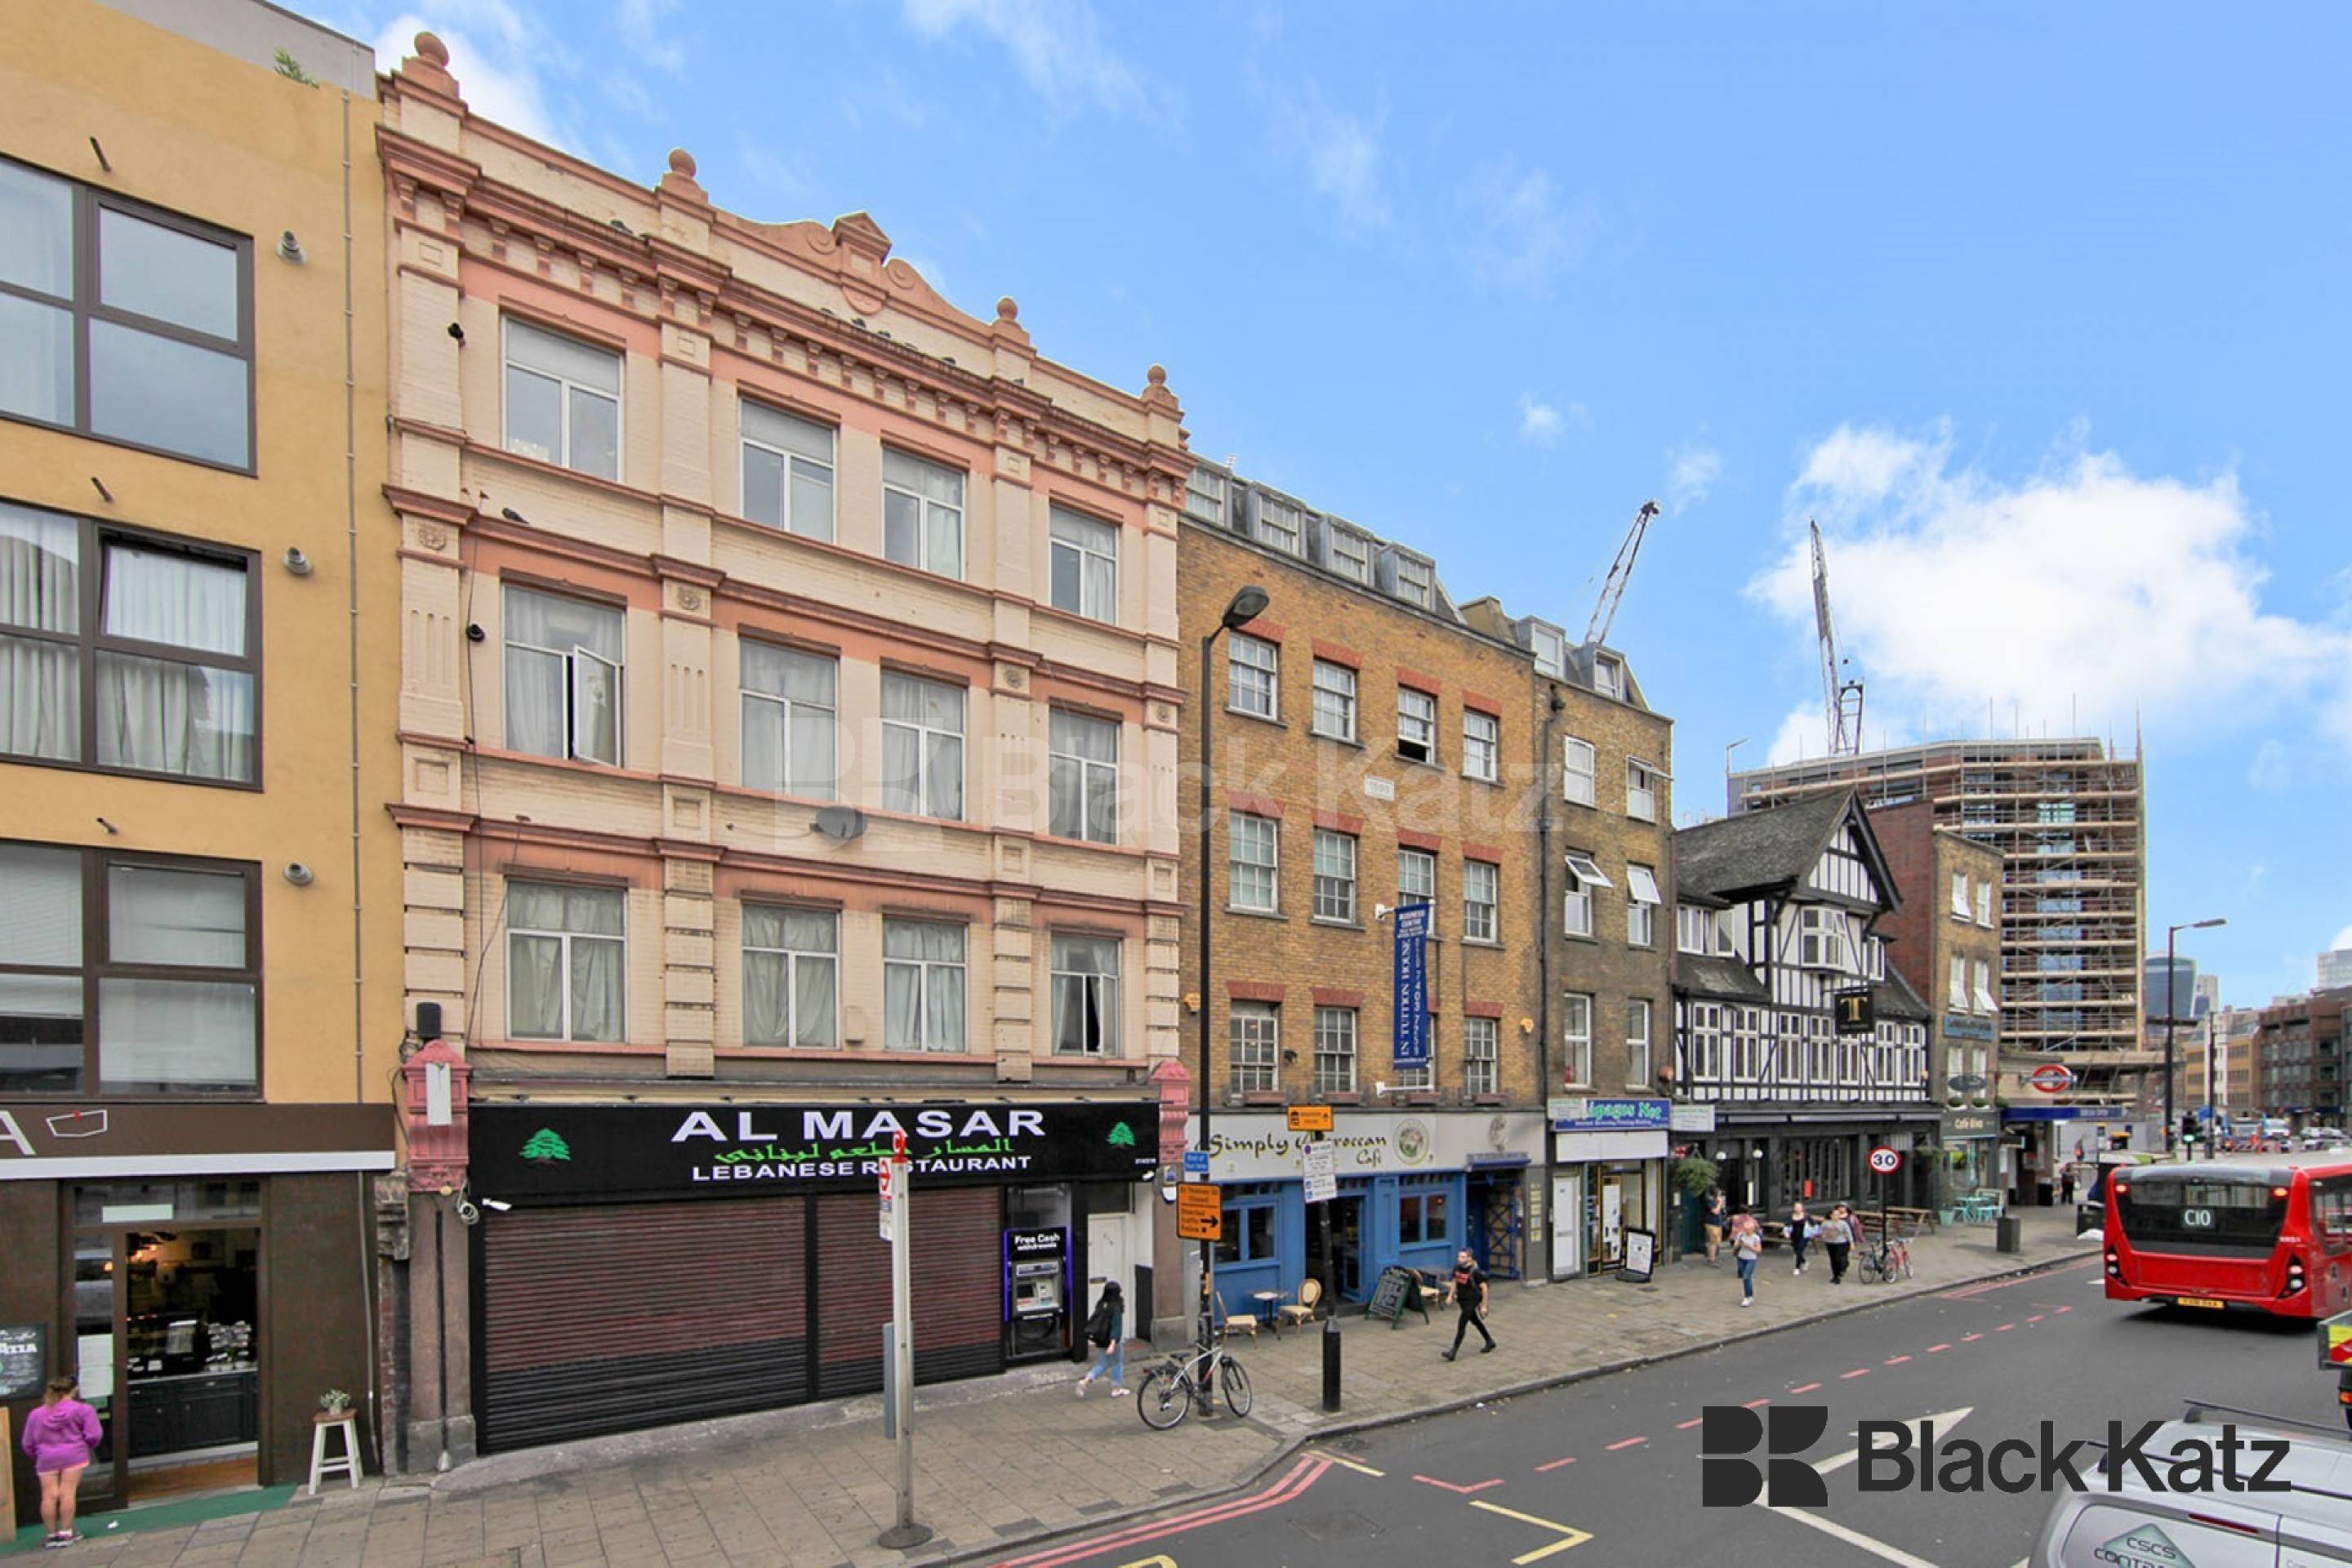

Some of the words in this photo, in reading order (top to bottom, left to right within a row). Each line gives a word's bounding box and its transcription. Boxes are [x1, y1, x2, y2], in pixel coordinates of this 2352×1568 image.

[670, 1111, 777, 1143] AL
[803, 1110, 1046, 1140] MASAR
[1196, 1132, 1290, 1158] Simply
[1873, 1153, 1895, 1166] 30
[693, 1162, 854, 1182] LEBANESE
[2184, 1209, 2212, 1226] C10
[2127, 1537, 2176, 1559] CSCS
